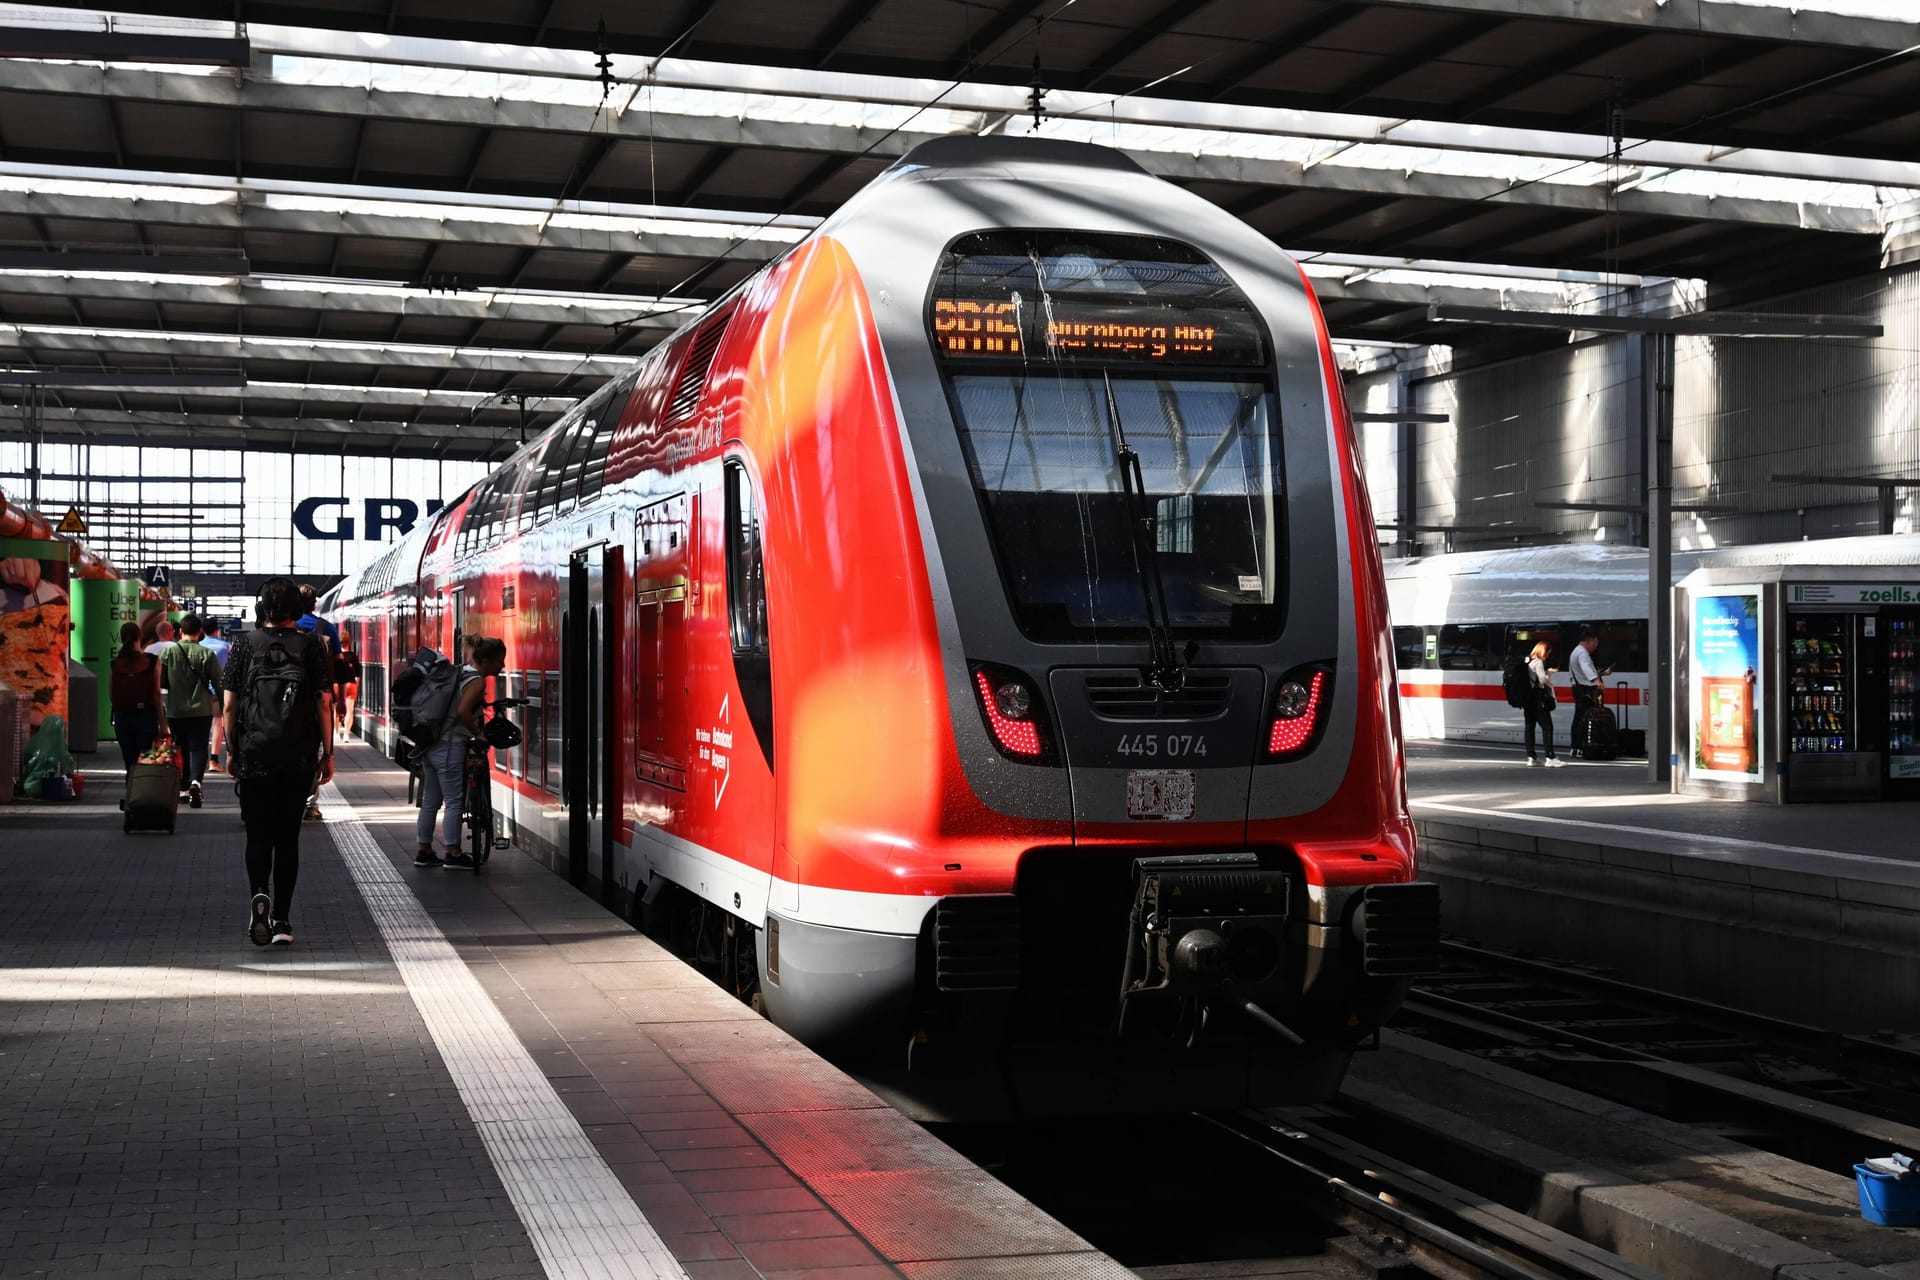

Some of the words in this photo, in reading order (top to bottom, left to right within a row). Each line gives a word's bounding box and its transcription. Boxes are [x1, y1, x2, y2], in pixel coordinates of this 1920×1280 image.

[152, 567, 165, 582] A
[110, 592, 137, 605] Uber
[187, 602, 195, 612] B
[110, 608, 137, 620] Eats
[1117, 735, 1158, 756] 445
[1167, 735, 1208, 757] 074
